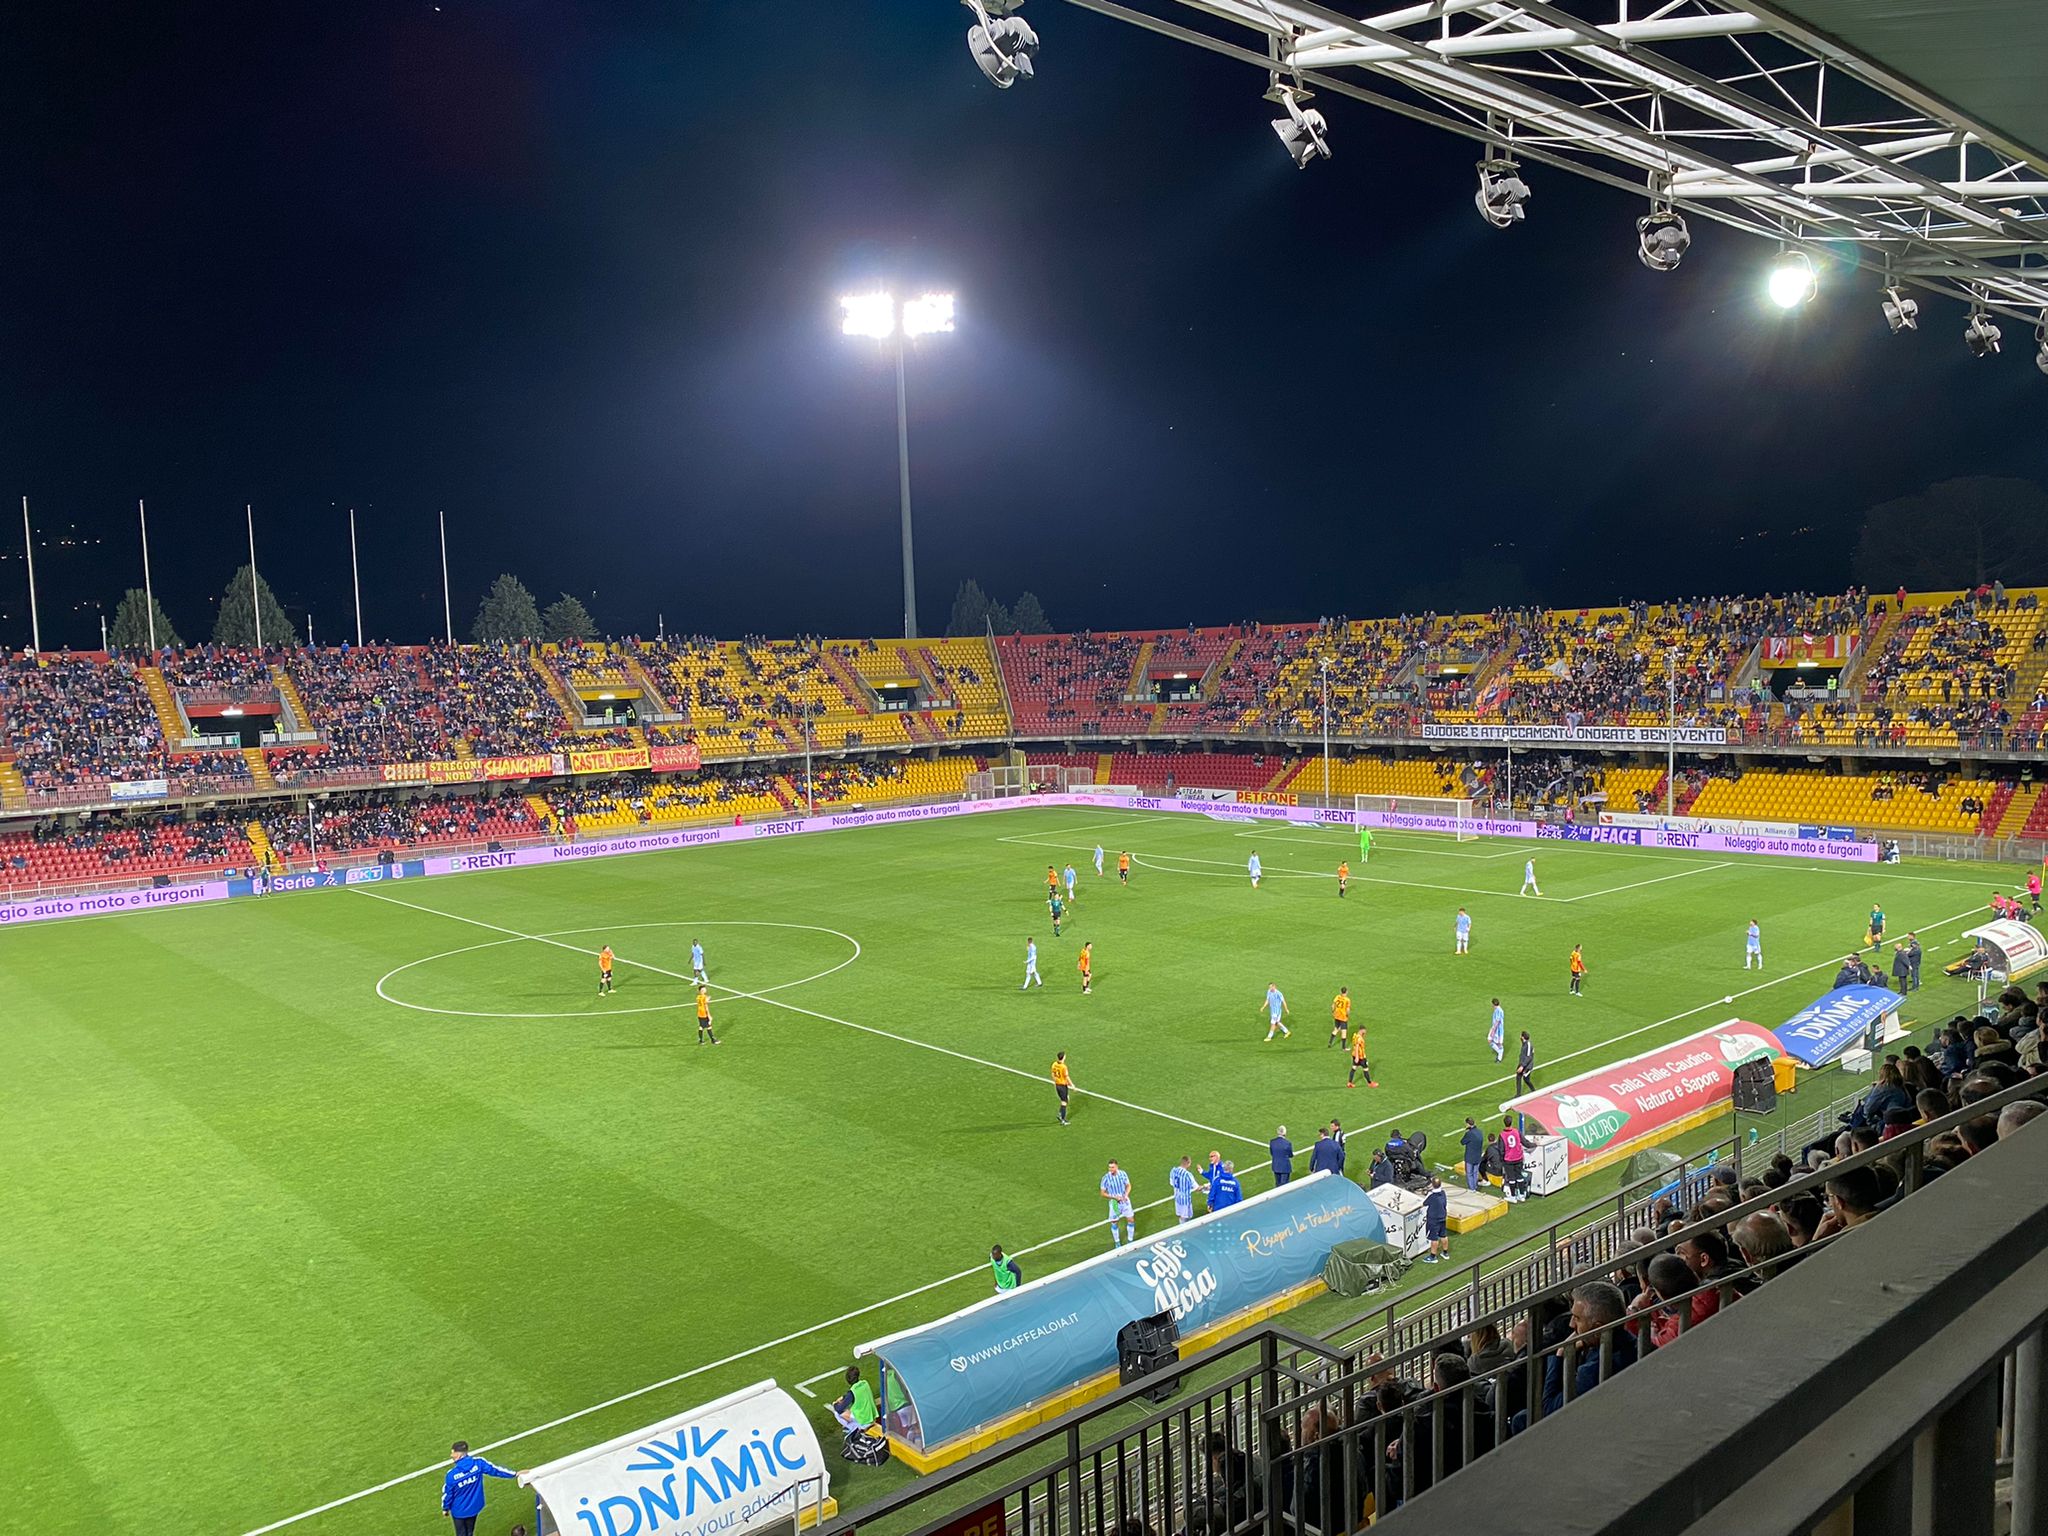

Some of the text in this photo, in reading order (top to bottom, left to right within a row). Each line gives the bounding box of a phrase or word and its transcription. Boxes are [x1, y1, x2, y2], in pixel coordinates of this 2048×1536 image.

[1424, 726, 1725, 742] SUDORE E ATTACCAMENTO ONORATE BENEVENTO
[430, 759, 482, 772] STREGONI
[446, 771, 472, 782] NORD
[483, 754, 551, 777] SHANGHAI
[1181, 800, 1212, 812] Noleggio
[1214, 804, 1231, 813] auto
[1232, 805, 1251, 814] moto
[1259, 806, 1287, 817] furgoni
[1236, 791, 1298, 807] PETRONE
[832, 803, 960, 826] Noleggio auto moto e furgoni
[1382, 813, 1522, 833] Noleggio auto moto e furgoni
[1579, 825, 1637, 845] for PEACE
[1764, 827, 1786, 835] Allianz
[553, 829, 720, 858] Noleggio auto moto e furgoni
[1724, 836, 1862, 858] Noleggio auto moto e furgoni
[274, 874, 315, 891] Serie
[349, 868, 382, 881] BKT
[34, 900, 73, 915] auto
[80, 896, 125, 911] moto
[130, 893, 140, 904] e
[145, 885, 205, 904] furgoni
[1810, 1026, 1851, 1056] accelerate
[1847, 1014, 1862, 1031] your
[1860, 996, 1892, 1020] advance
[1609, 1075, 1646, 1097] Dalla
[1637, 1064, 1672, 1086] Valle
[1665, 1050, 1713, 1075] Caudina
[1635, 1070, 1720, 1113] Natura e Sapore
[1507, 1134, 1517, 1148] 9
[1574, 1115, 1619, 1149] MAURO
[967, 1312, 1079, 1366] WWW.CAFFEALOIA.IT
[699, 1508, 736, 1536] your
[741, 1479, 811, 1522] advance
